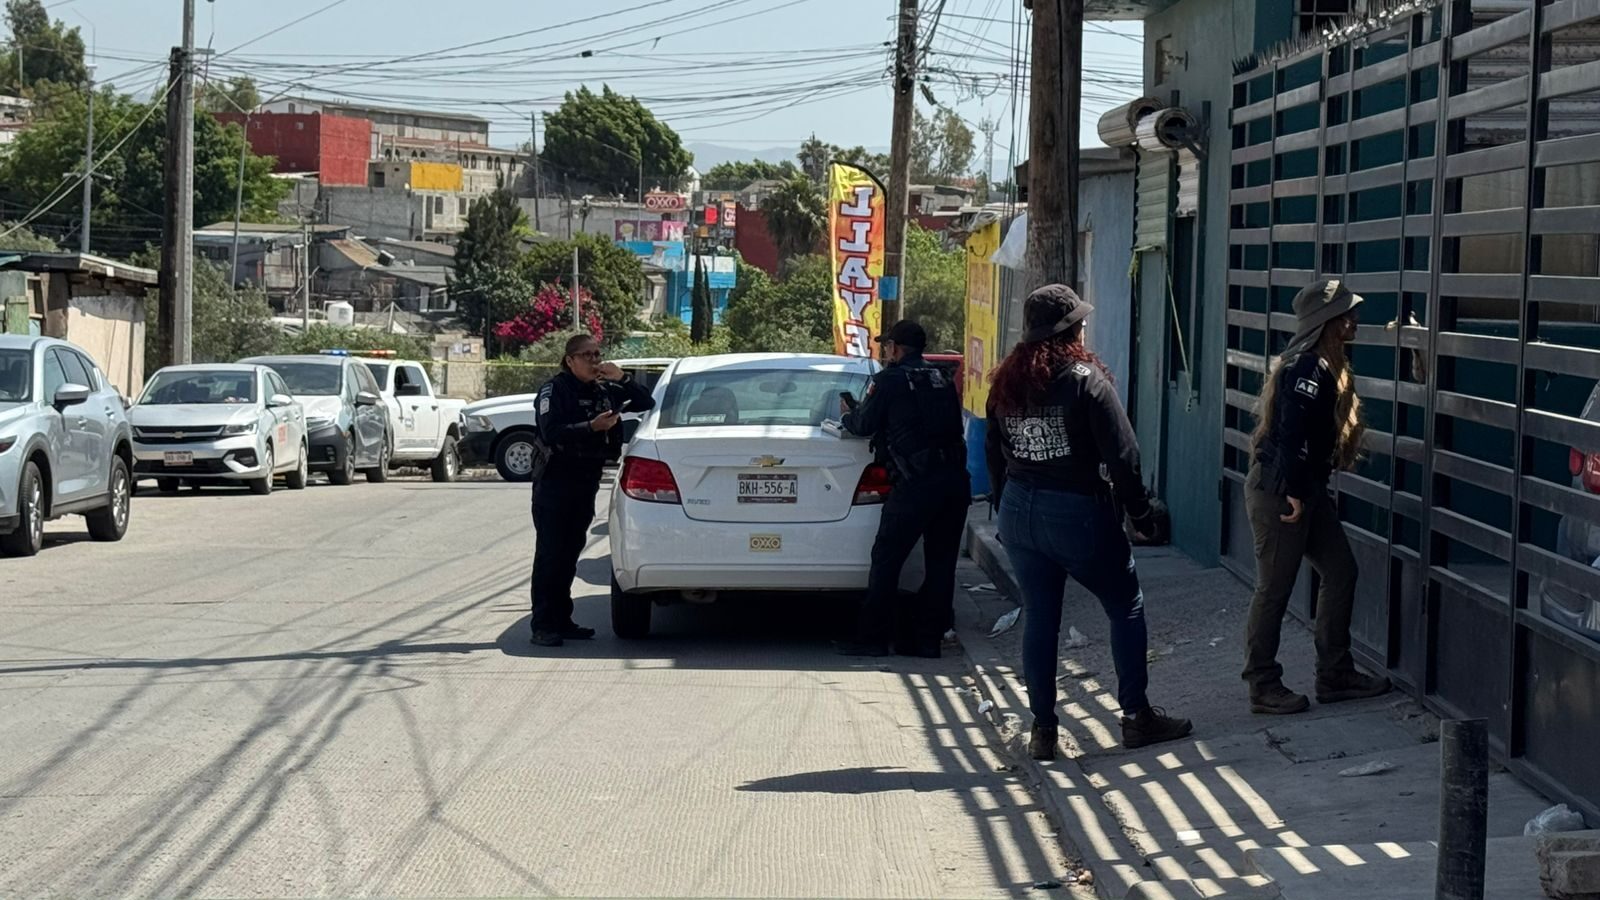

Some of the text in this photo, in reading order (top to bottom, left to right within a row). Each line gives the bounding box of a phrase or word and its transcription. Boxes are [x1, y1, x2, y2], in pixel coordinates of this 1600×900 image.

[646, 196, 679, 208] OXXO
[1298, 382, 1318, 396] AEI
[1044, 406, 1064, 416] FGE
[1030, 451, 1048, 461] AEI
[1049, 446, 1071, 458] FGE
[739, 481, 796, 495] BKH-556-A
[751, 537, 781, 549] OXXO
